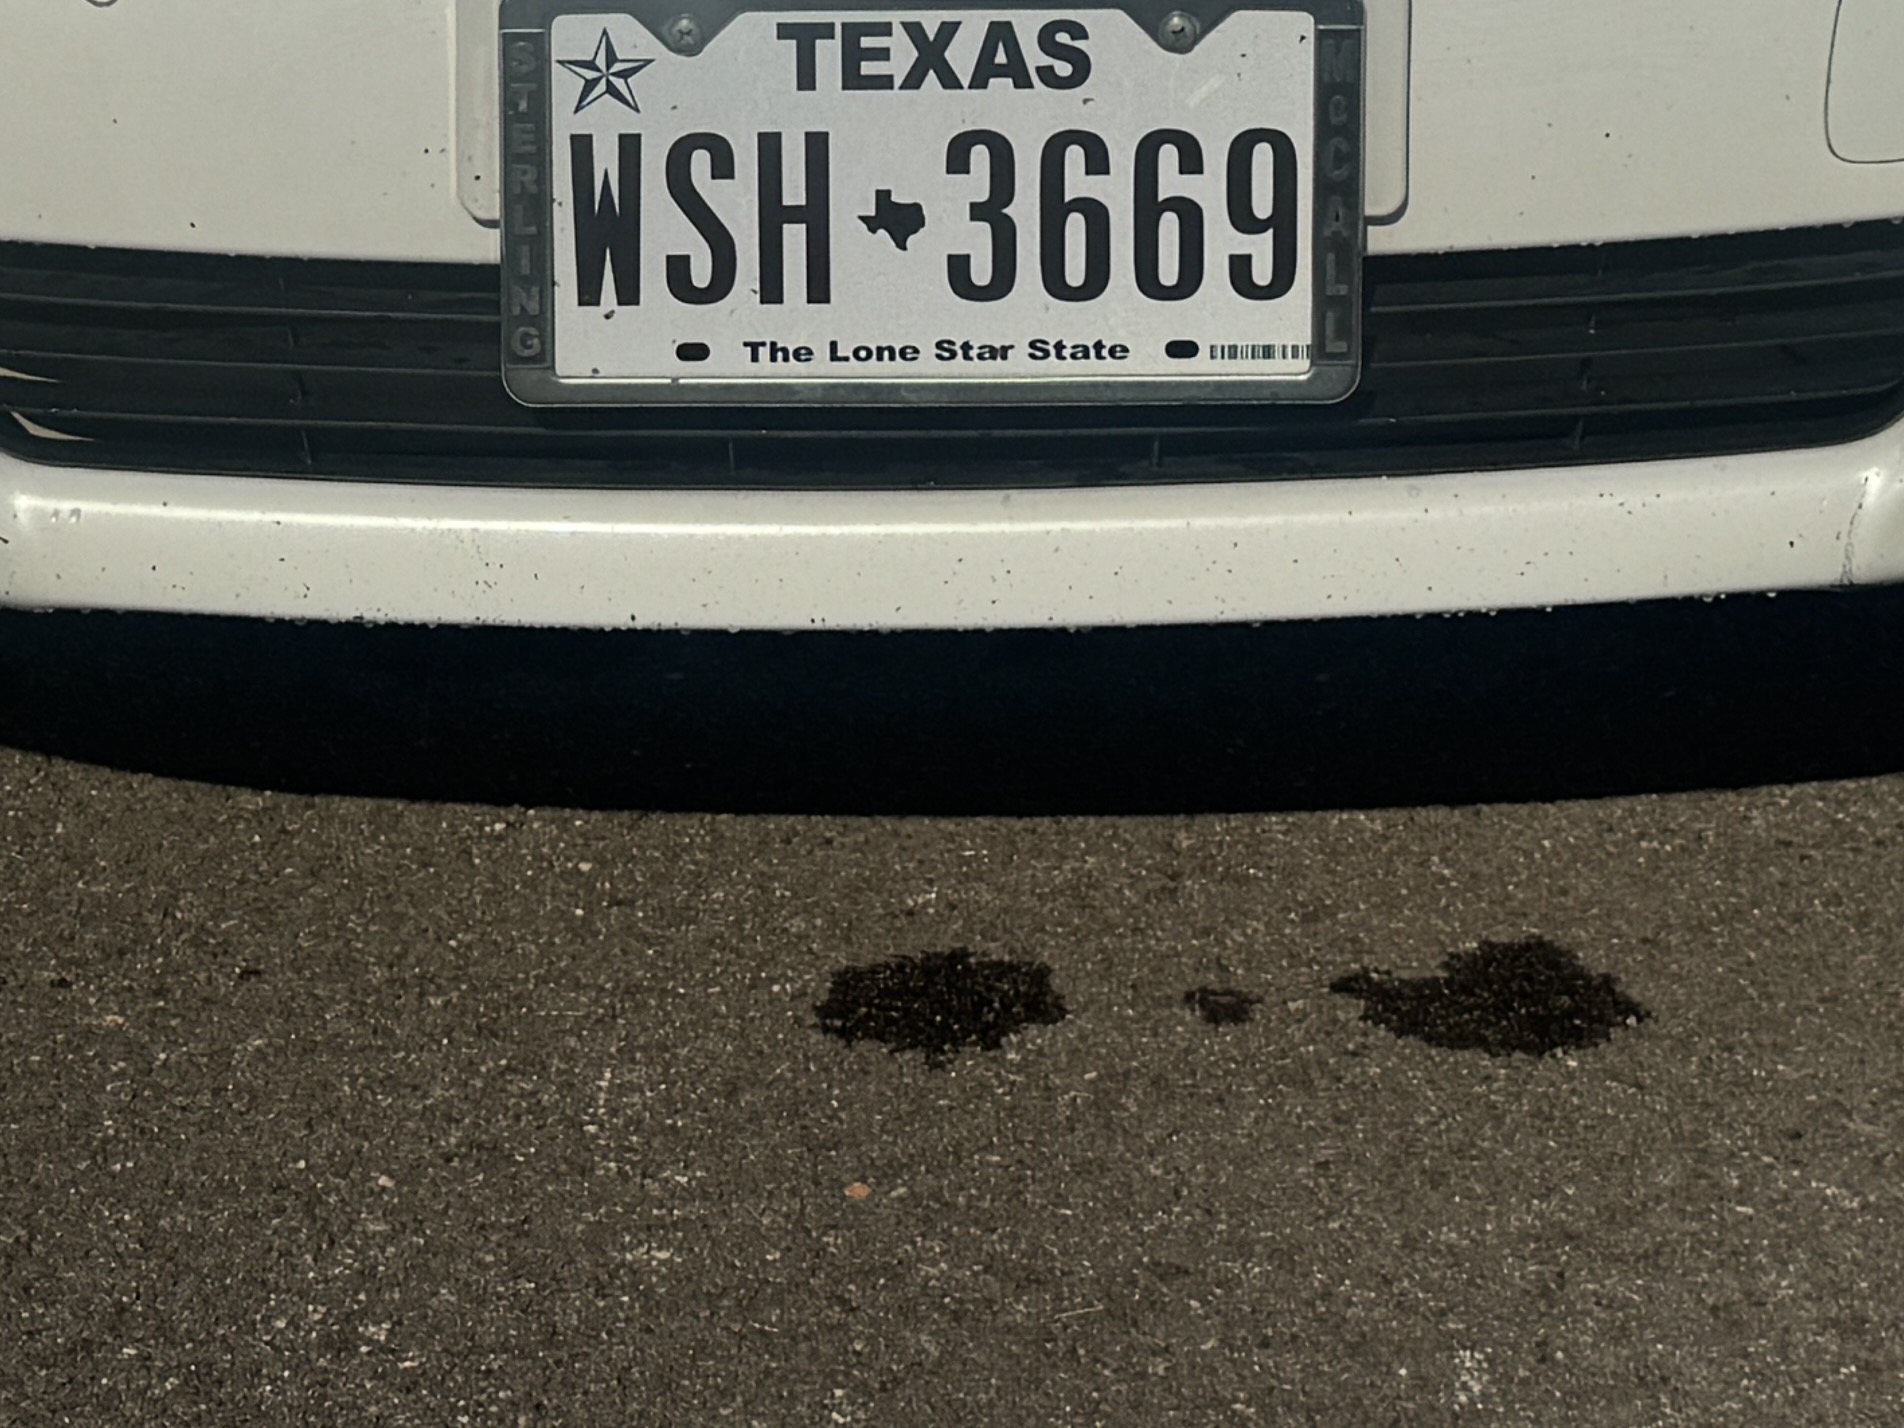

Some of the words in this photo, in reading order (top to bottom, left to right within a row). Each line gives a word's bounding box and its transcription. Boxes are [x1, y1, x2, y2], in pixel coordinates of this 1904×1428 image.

[777, 20, 1092, 91] TEXAS
[510, 41, 541, 358] STERLING
[570, 133, 832, 307] WSH
[945, 128, 1298, 302] 3669
[742, 341, 814, 363] The
[828, 340, 921, 362] Lone
[934, 338, 1015, 361] Star
[1027, 337, 1130, 361] State
